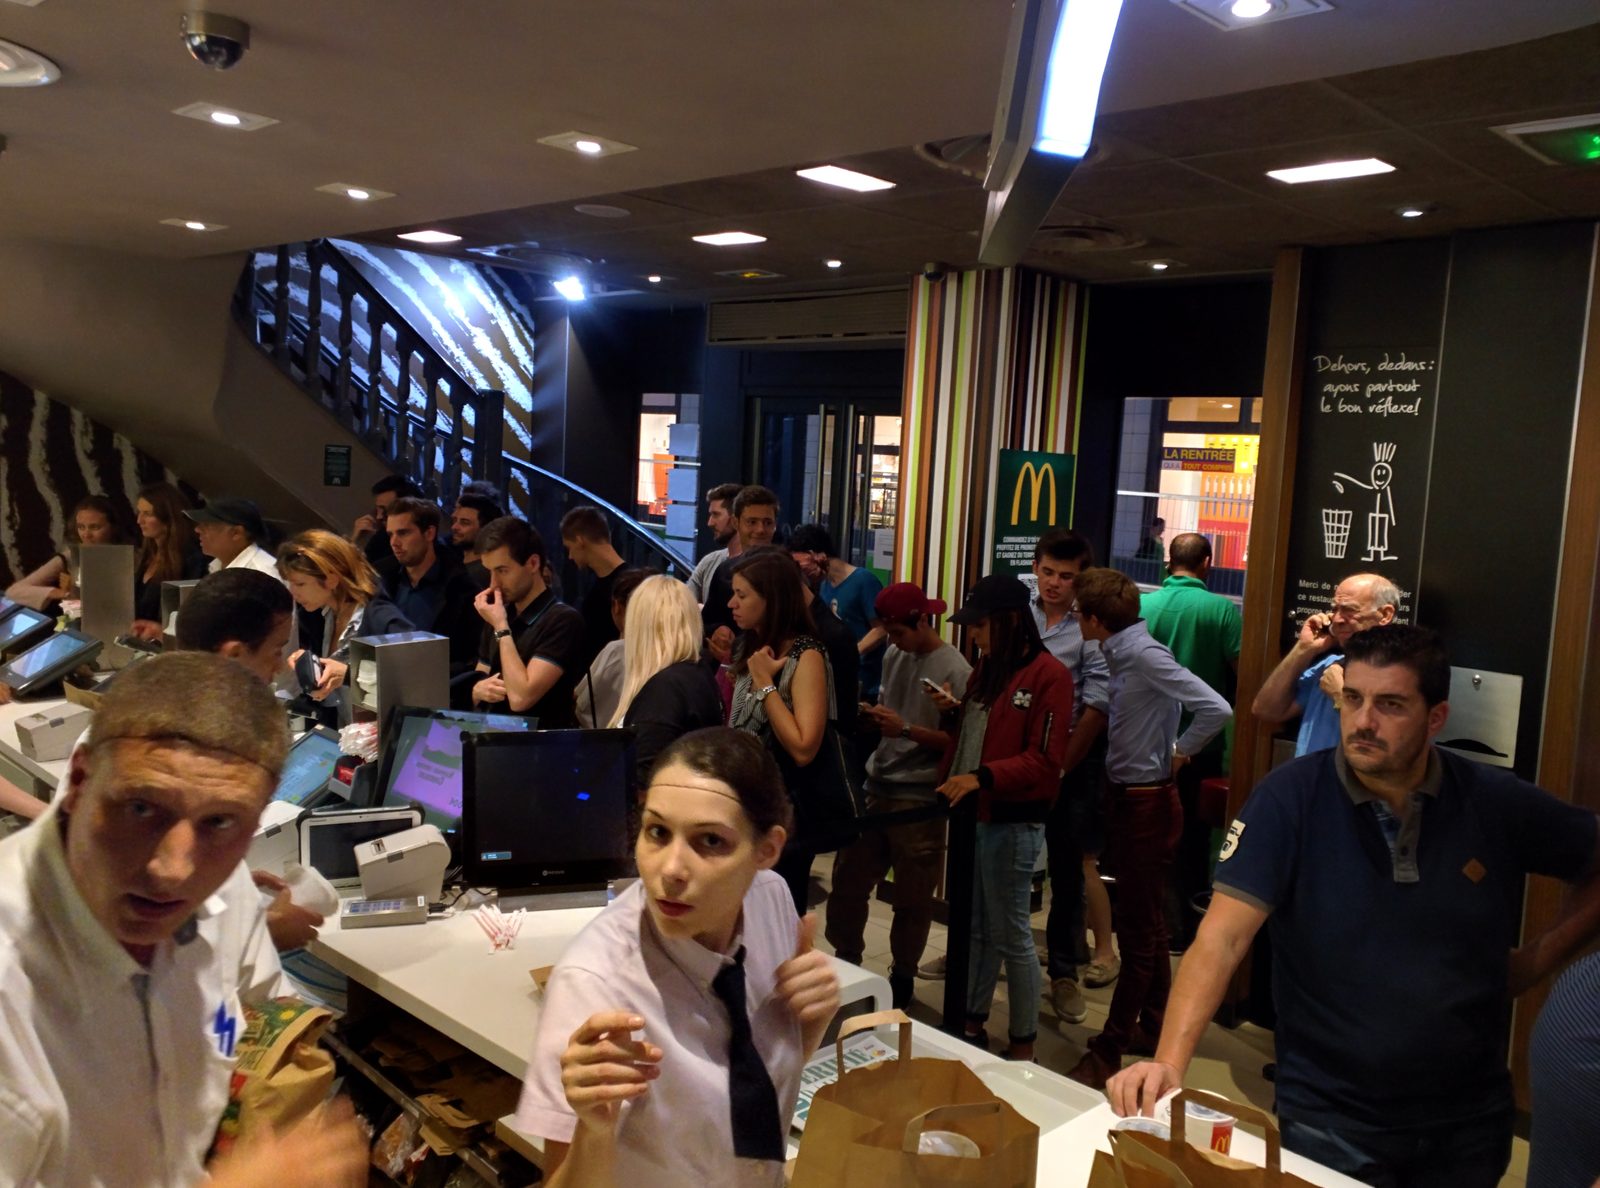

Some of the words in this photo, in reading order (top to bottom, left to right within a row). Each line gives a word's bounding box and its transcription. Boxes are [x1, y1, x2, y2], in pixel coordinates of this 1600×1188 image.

[1313, 355, 1371, 374] Dehors,
[1378, 352, 1435, 371] dedans:
[1323, 383, 1360, 398] ayons
[1365, 379, 1420, 398] partout
[1320, 396, 1332, 413] le
[1338, 398, 1362, 413] bon
[1368, 396, 1421, 417] réflexe!
[1164, 449, 1179, 459] LA
[1180, 448, 1235, 461] RENTRÉE
[1299, 579, 1319, 589] Merci
[1321, 582, 1331, 590] de
